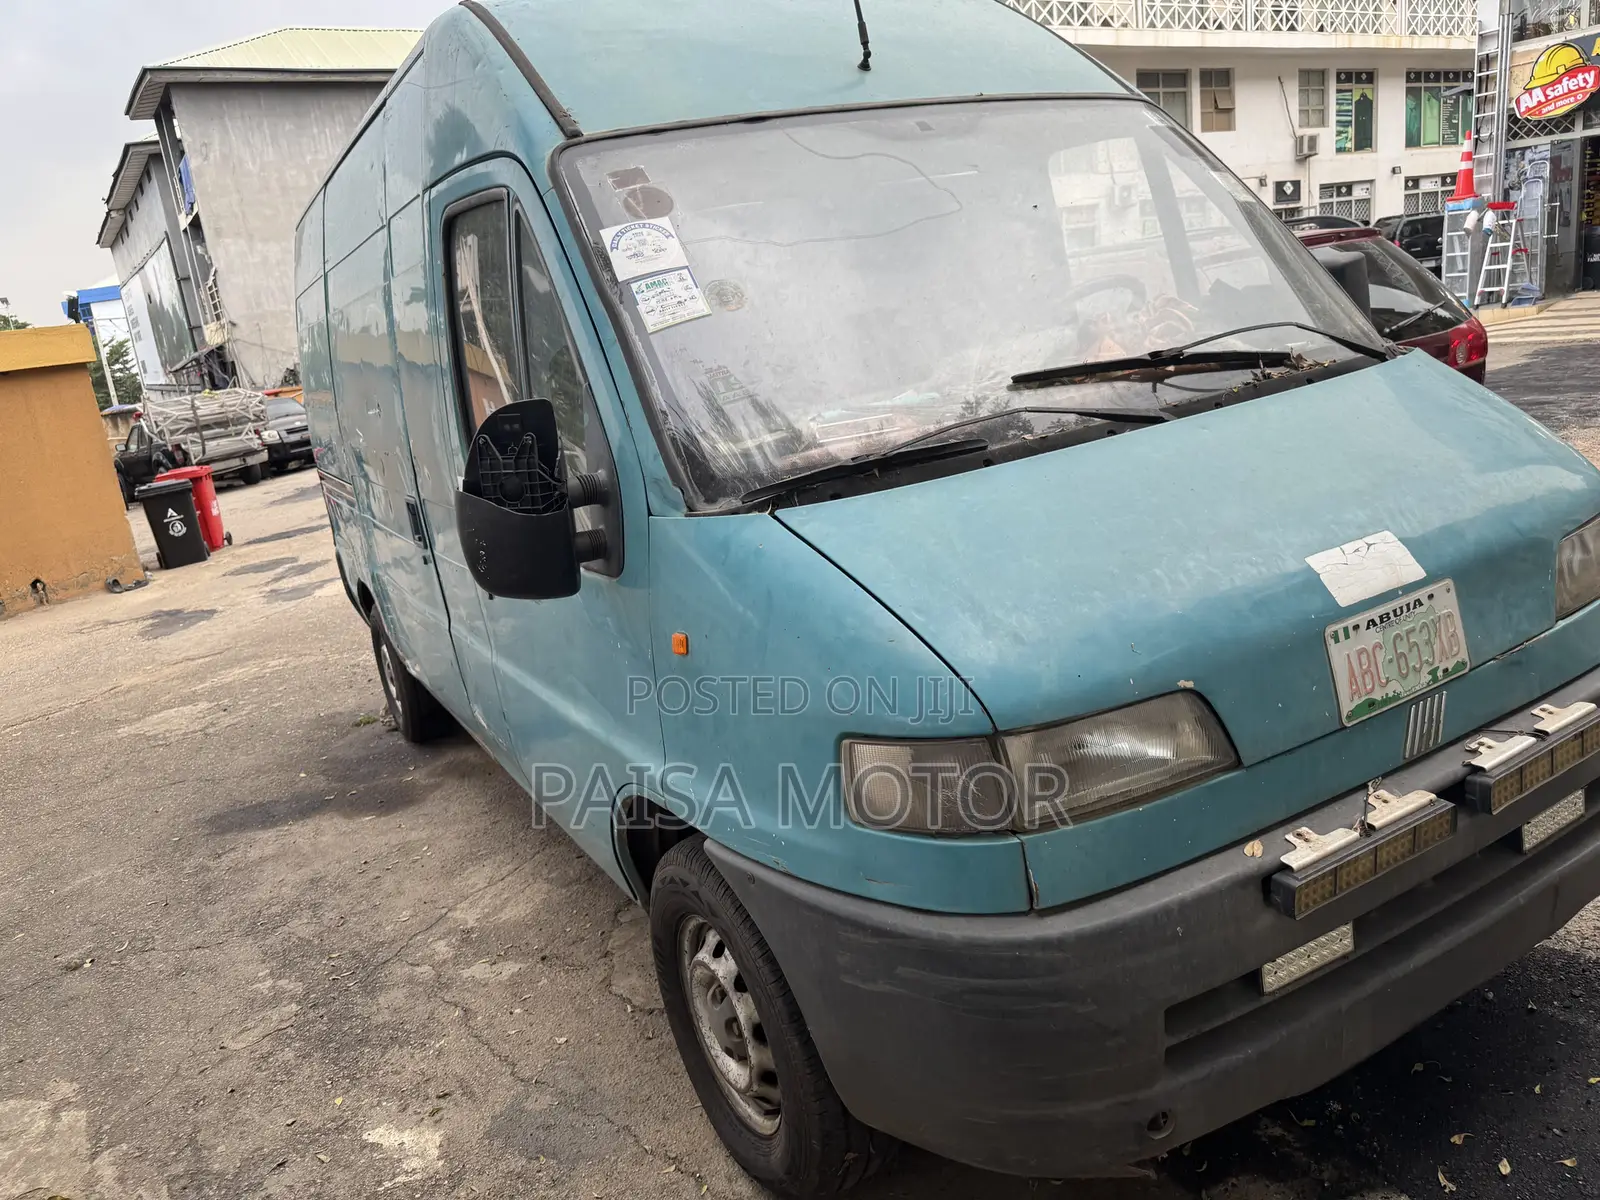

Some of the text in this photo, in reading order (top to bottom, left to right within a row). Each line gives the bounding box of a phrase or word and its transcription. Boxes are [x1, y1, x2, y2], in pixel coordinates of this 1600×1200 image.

[1519, 70, 1595, 113] AA safety
[1541, 96, 1575, 115] and more
[622, 223, 644, 234] TICKET
[1365, 598, 1425, 631] ABUJA
[1375, 620, 1395, 634] CENTRE
